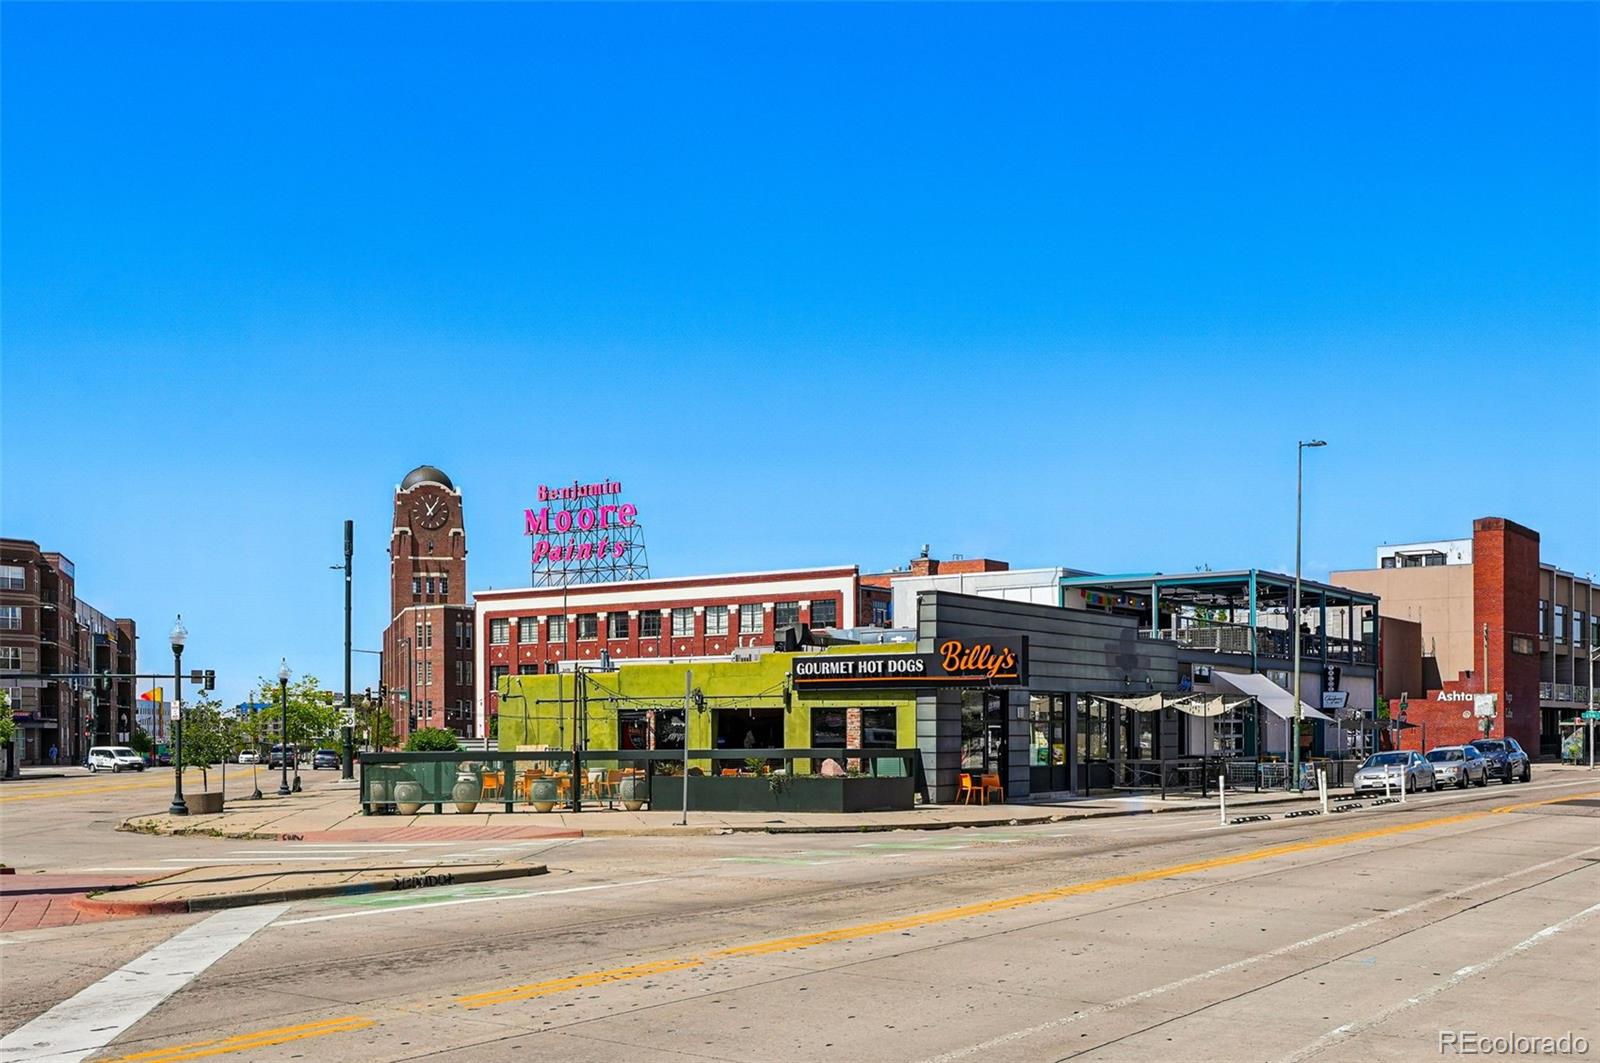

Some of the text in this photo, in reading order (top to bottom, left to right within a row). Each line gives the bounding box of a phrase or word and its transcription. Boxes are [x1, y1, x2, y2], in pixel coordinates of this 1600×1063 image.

[537, 479, 620, 501] Benjamin
[523, 503, 637, 535] Moore
[532, 536, 626, 564] Paints
[796, 659, 924, 675] GOURMET HOT DOGS
[940, 640, 1015, 678] Billy's
